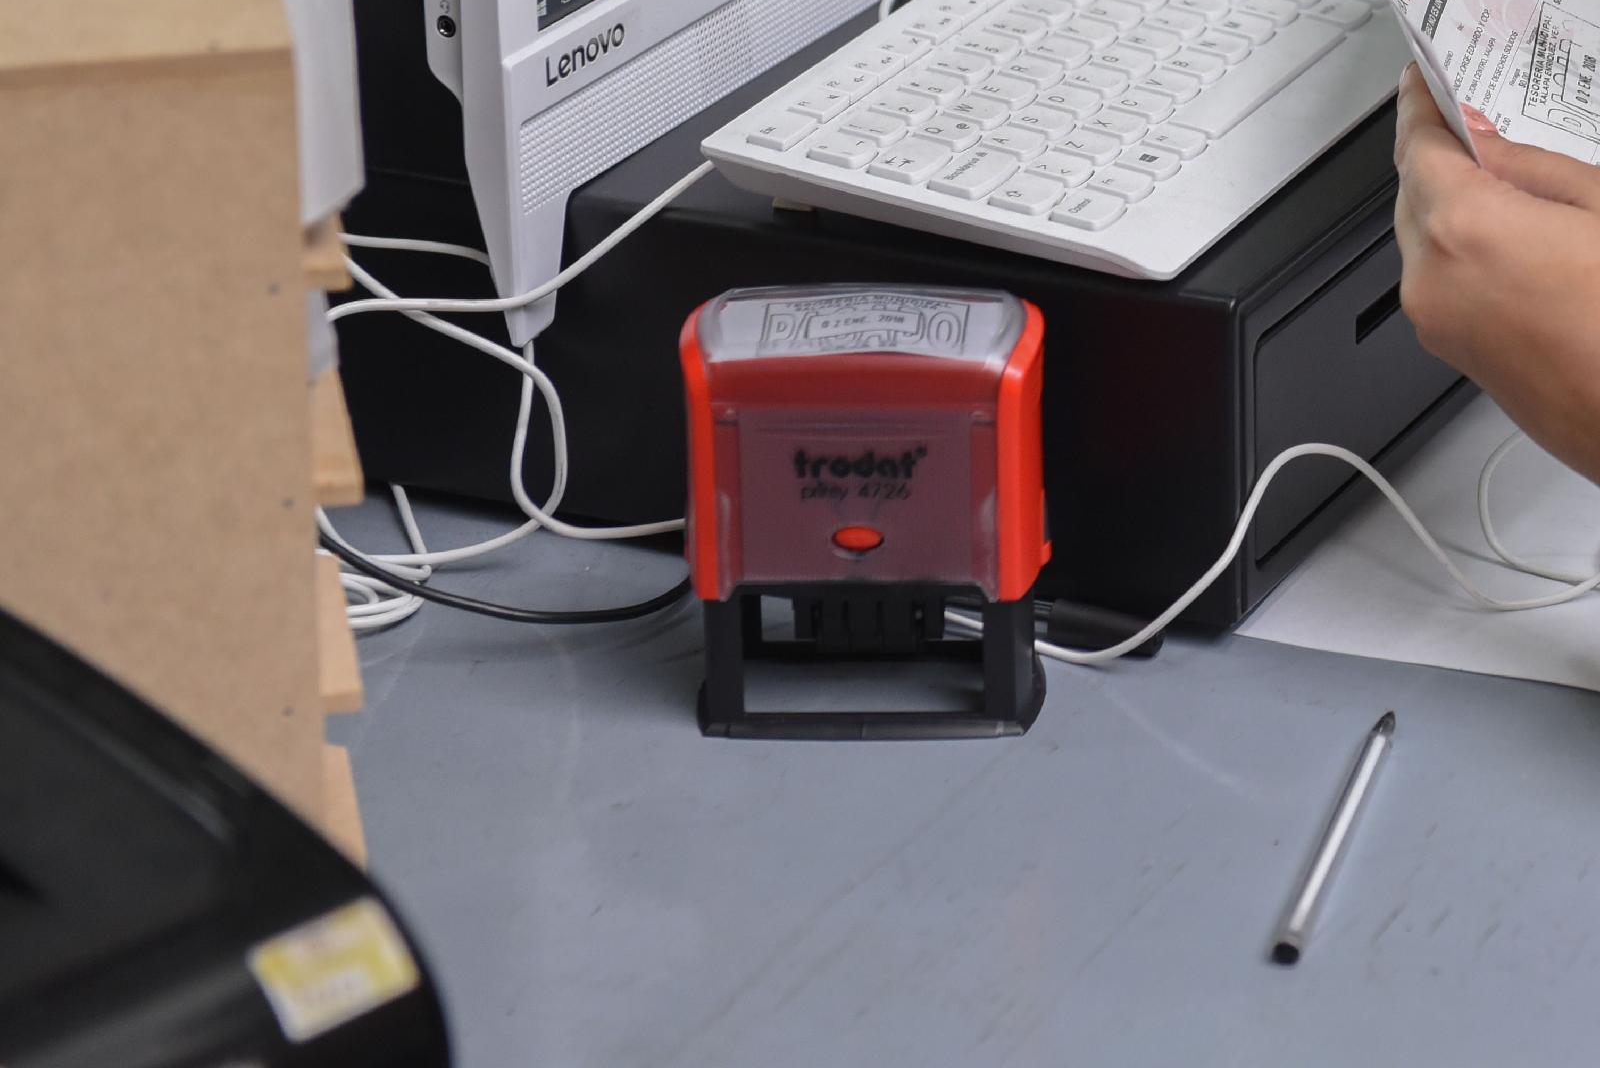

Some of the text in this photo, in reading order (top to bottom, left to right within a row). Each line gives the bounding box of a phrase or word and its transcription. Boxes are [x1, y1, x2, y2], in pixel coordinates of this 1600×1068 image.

[1430, 5, 1440, 18] ES
[546, 23, 625, 87] Lenovo
[1459, 53, 1472, 75] JORGE
[1466, 26, 1483, 56] EDUARDO
[1491, 53, 1509, 83] DESECHOS
[1503, 30, 1519, 55] SOLIDOS
[1528, 12, 1553, 107] TESORERIA MUNICIPAL
[1581, 52, 1598, 74] 2018
[1518, 71, 1530, 89] $0.00
[1498, 117, 1511, 135] $0.00
[794, 449, 914, 480] trodat
